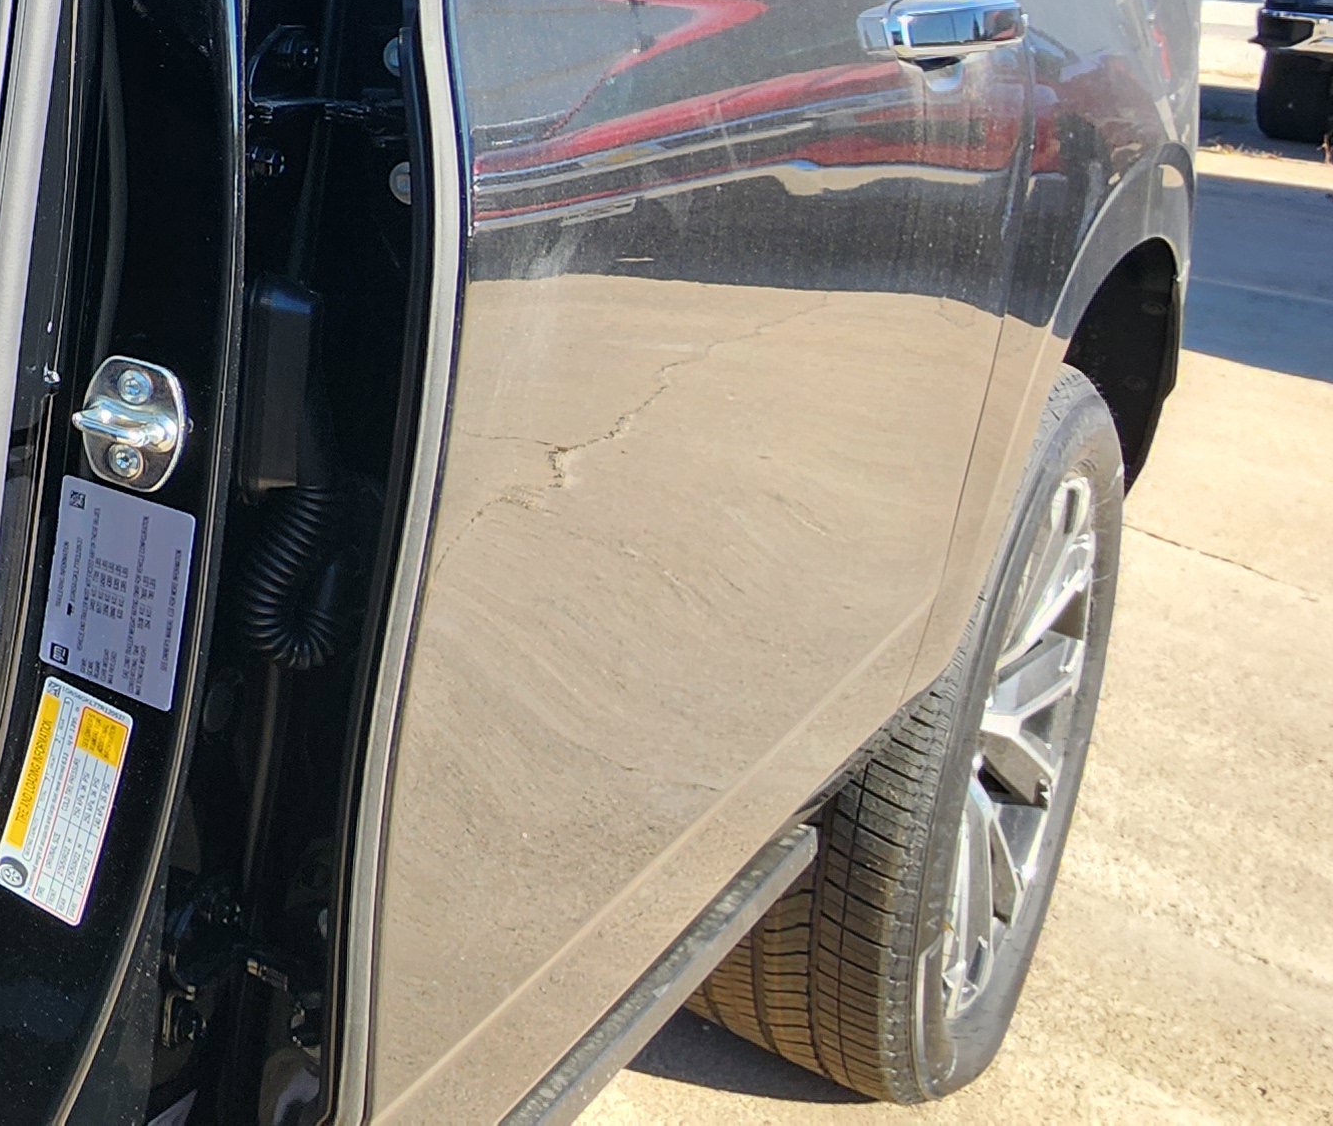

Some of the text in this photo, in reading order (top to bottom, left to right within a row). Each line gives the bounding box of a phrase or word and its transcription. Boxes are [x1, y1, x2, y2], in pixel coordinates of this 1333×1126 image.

[31, 717, 53, 764] INFORMATION
[23, 761, 41, 795] LOADING
[19, 791, 33, 809] AND
